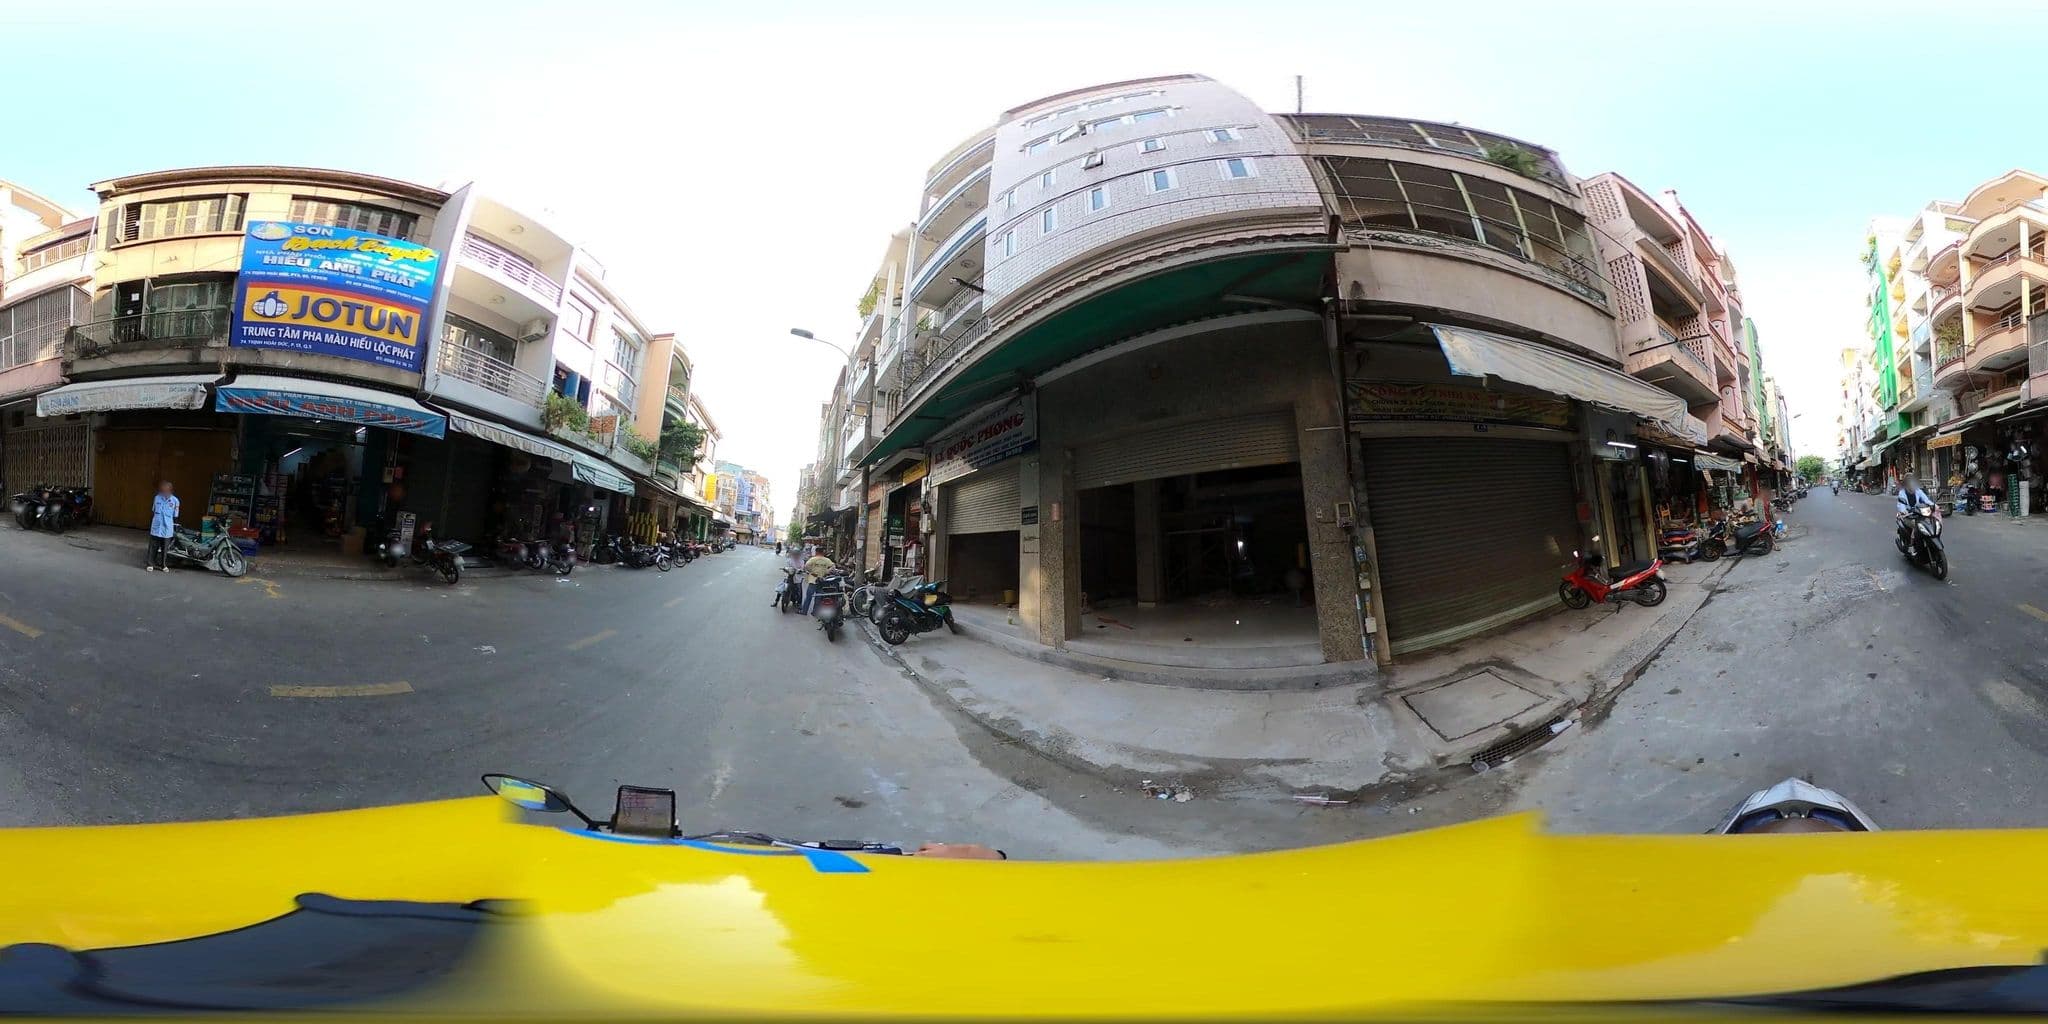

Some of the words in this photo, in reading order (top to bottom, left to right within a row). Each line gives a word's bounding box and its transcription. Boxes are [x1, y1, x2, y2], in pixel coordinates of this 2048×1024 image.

[293, 225, 334, 238] SƠN
[318, 259, 362, 275] ANH
[292, 295, 413, 338] JOTUN
[242, 326, 276, 338] TRUNG
[278, 326, 301, 340] TÂM
[303, 330, 323, 342] PHA
[324, 332, 348, 346] MÀU
[349, 336, 372, 350] HIẾU
[373, 341, 391, 355] LỘC
[391, 347, 415, 360] PHÁT
[976, 412, 1025, 443] PHONG
